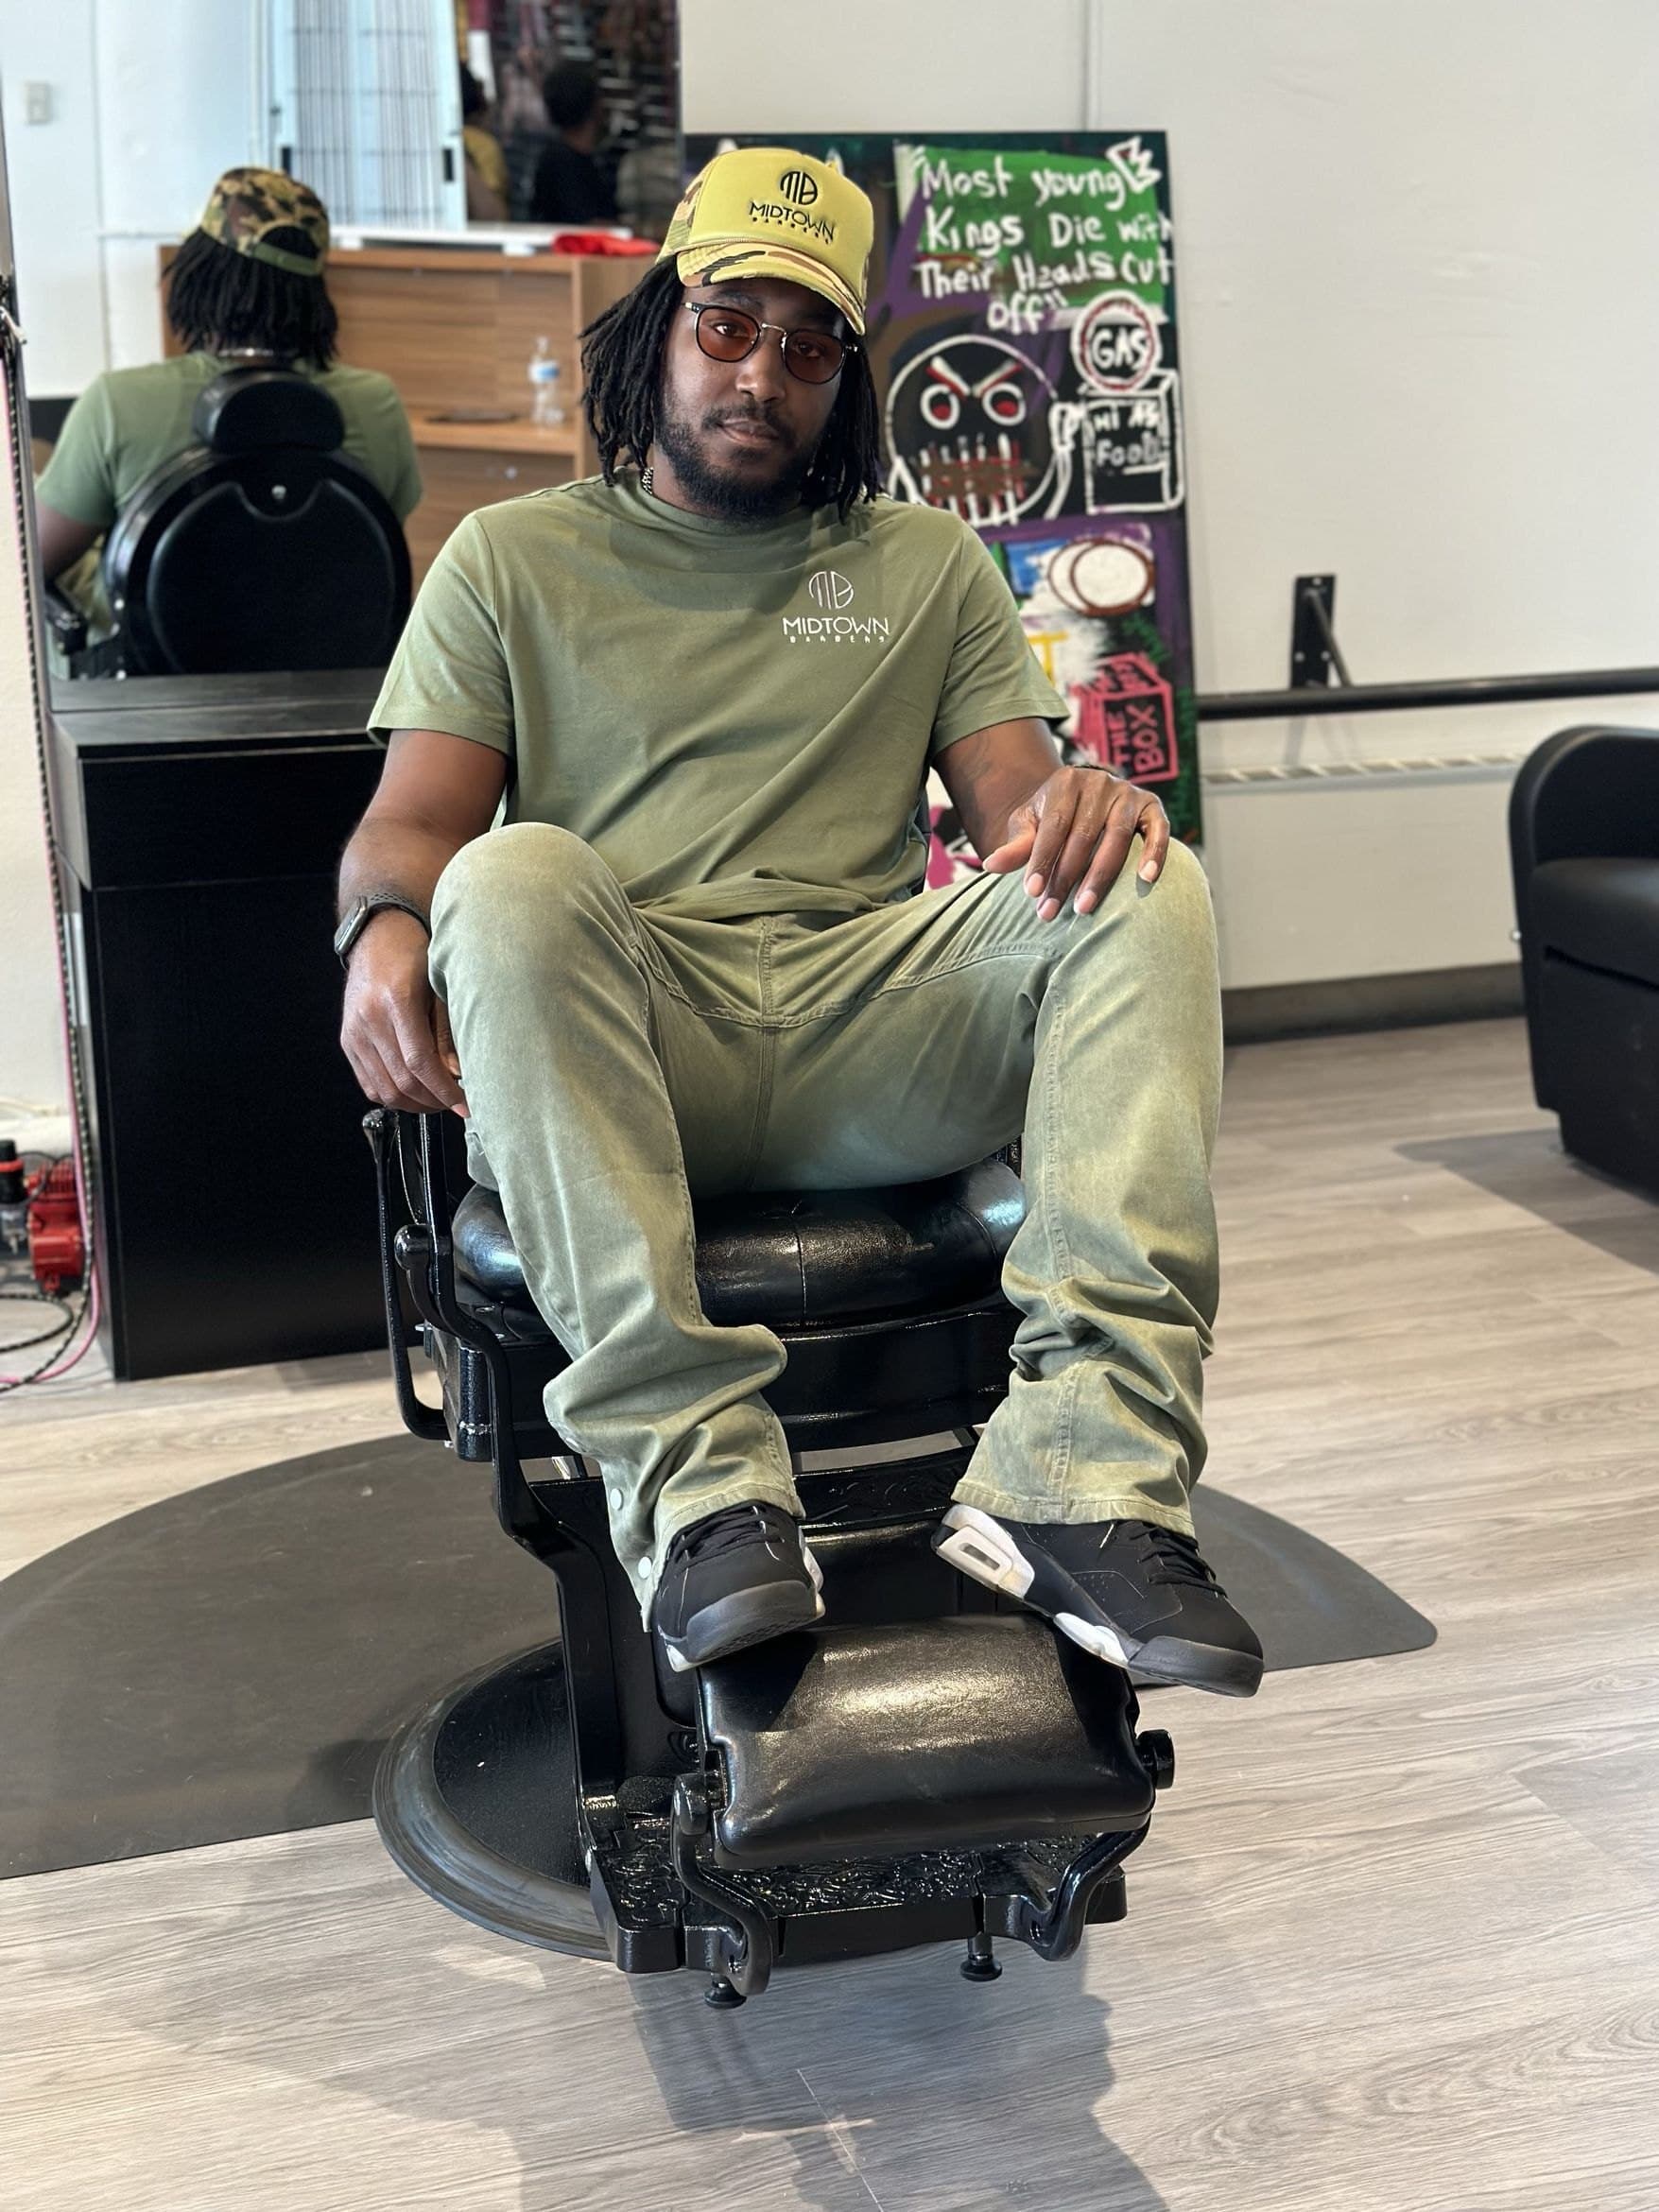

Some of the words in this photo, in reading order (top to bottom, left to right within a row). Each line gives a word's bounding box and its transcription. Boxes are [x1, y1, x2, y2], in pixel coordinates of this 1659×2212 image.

[1030, 166, 1126, 212] young
[749, 200, 836, 242] MIDTOWN
[925, 204, 1026, 258] Kings
[1048, 211, 1107, 248] Die
[1115, 210, 1174, 242] with
[913, 258, 995, 299] Their
[1011, 250, 1117, 293] Heads
[1091, 326, 1149, 371] GAS
[782, 616, 890, 635] MIDTOWN
[1125, 704, 1166, 773] BOX
